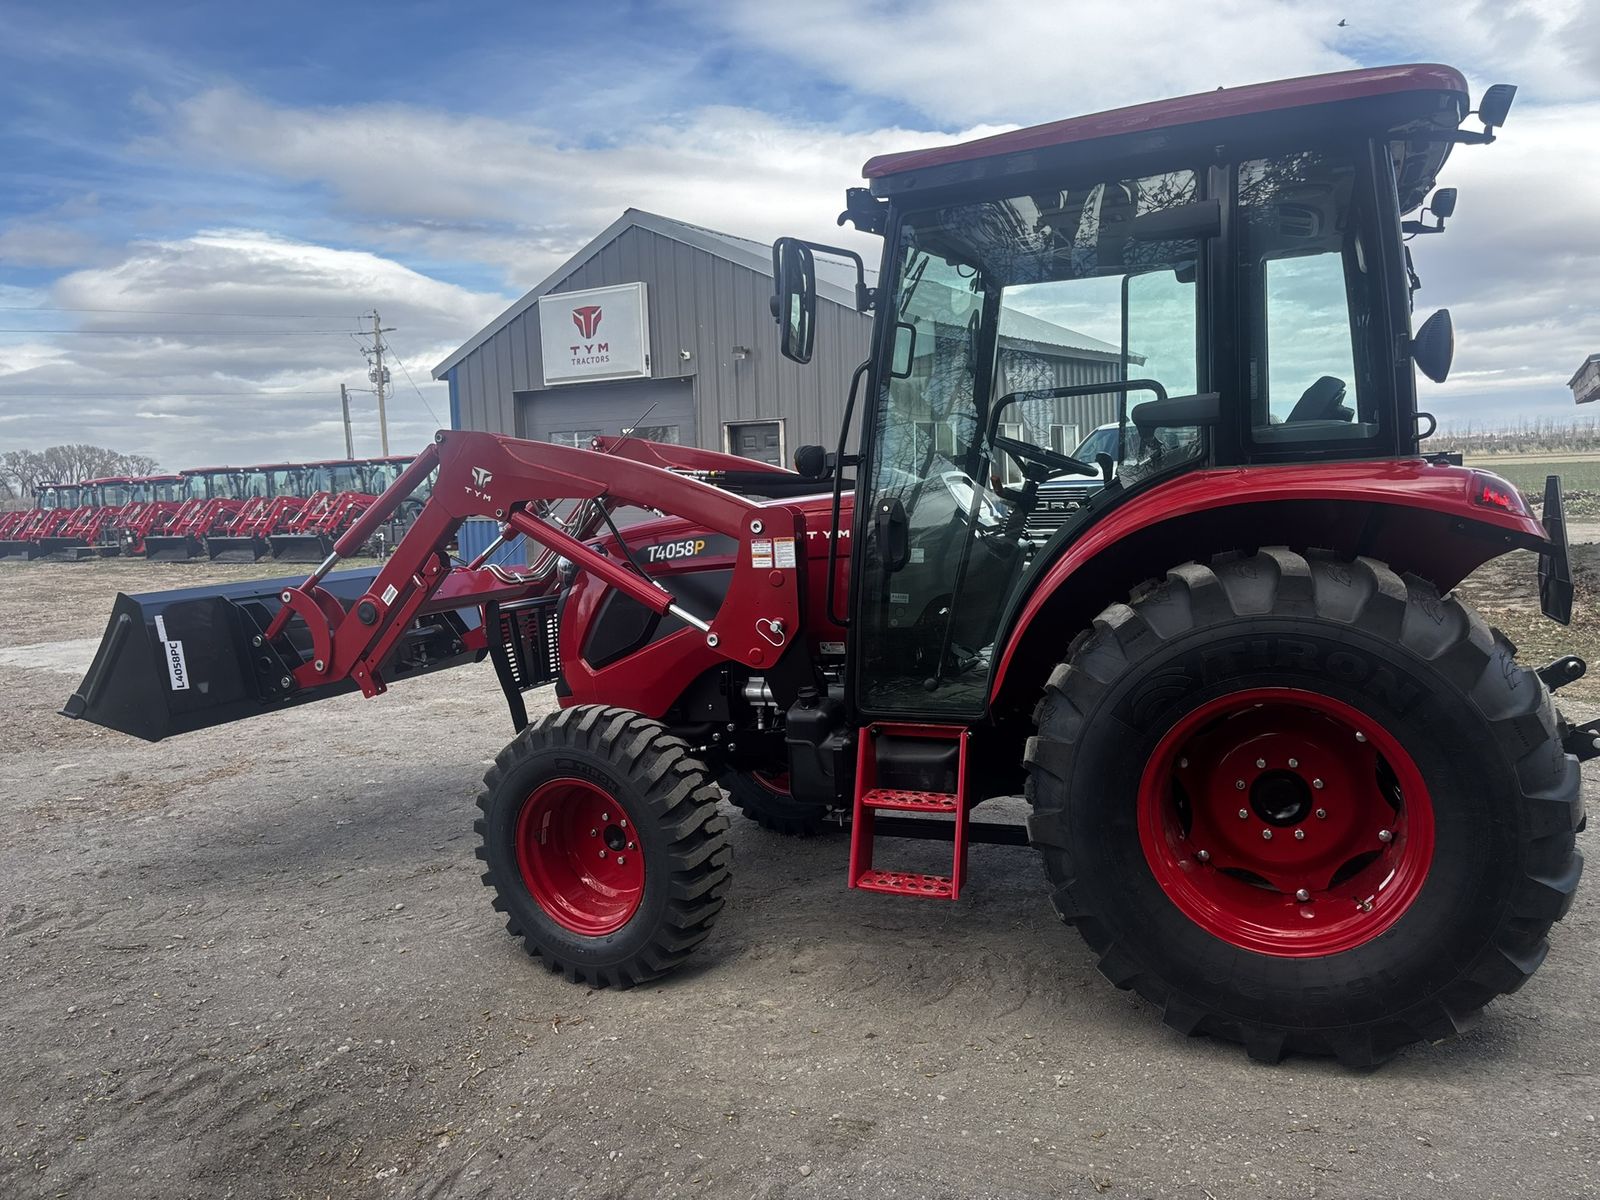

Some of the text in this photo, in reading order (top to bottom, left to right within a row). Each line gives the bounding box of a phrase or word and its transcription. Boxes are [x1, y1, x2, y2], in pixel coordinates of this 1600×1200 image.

[570, 343, 609, 356] TYM
[572, 355, 610, 365] TRACTORS
[464, 486, 491, 502] TYM
[806, 529, 850, 540] TYM
[648, 540, 705, 562] T4058P
[169, 642, 185, 688] L4058PC
